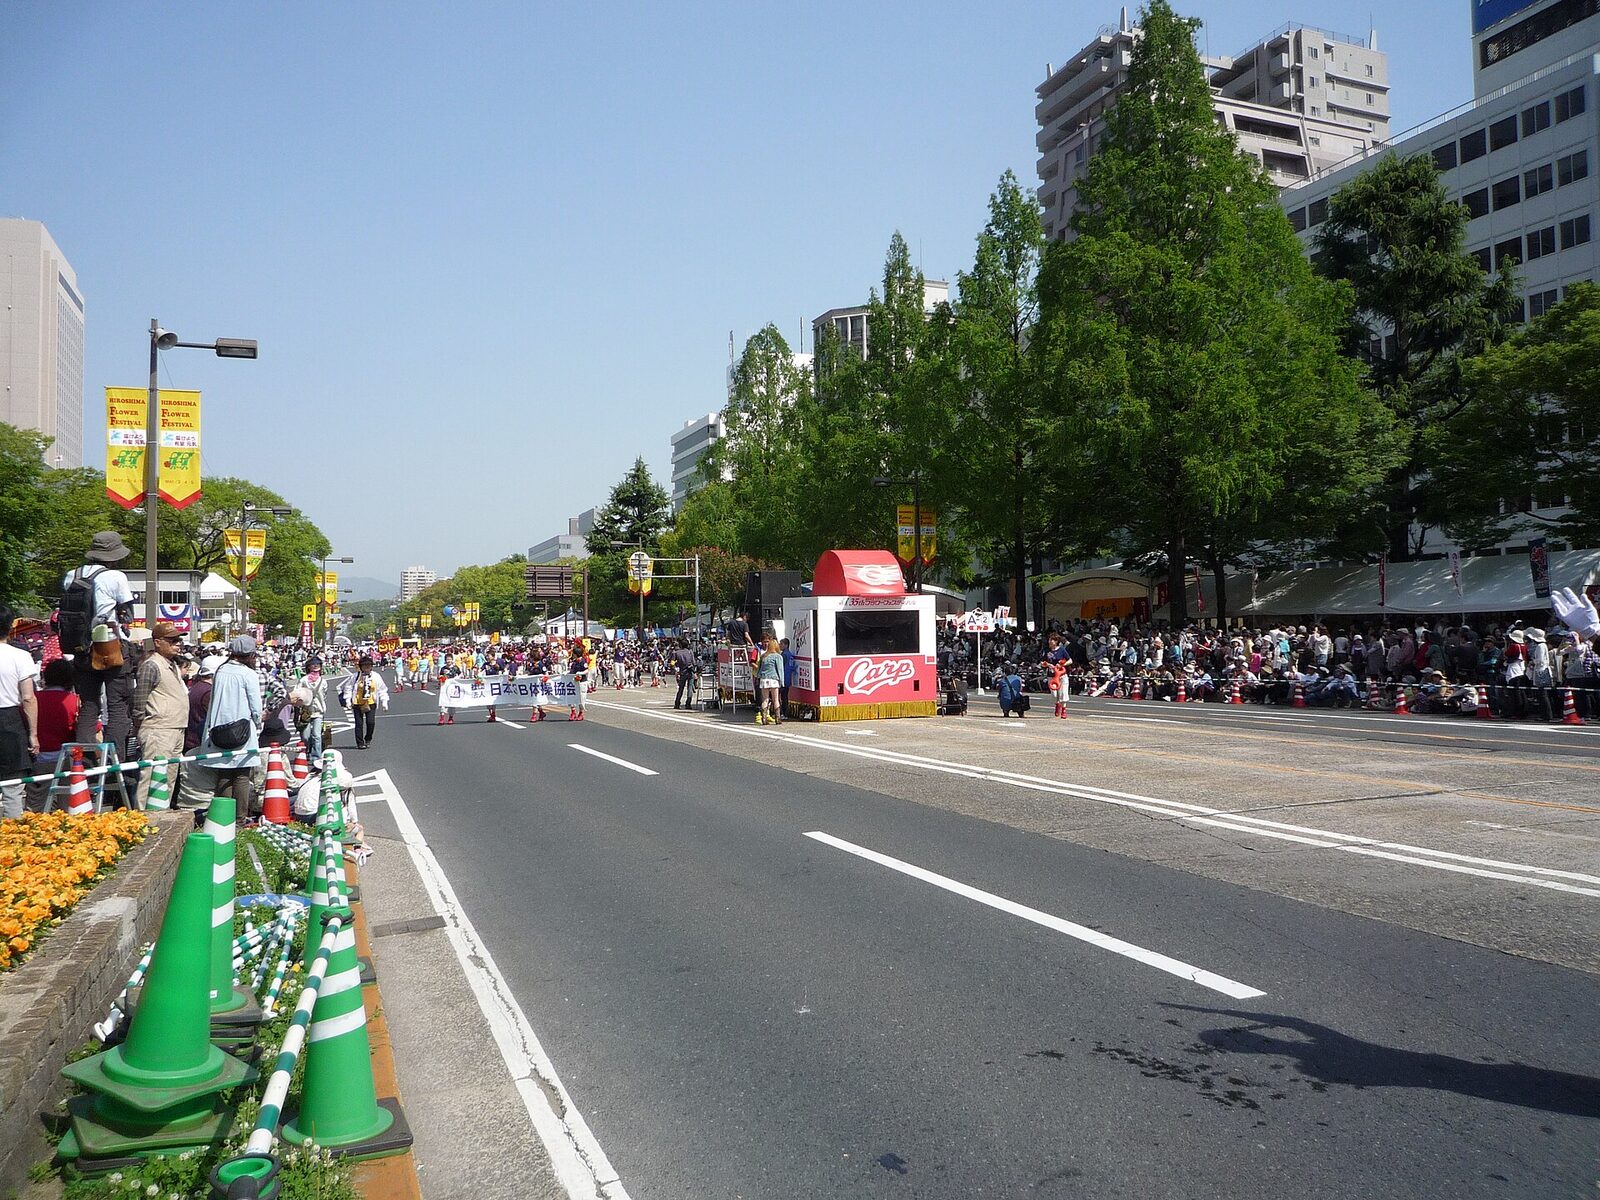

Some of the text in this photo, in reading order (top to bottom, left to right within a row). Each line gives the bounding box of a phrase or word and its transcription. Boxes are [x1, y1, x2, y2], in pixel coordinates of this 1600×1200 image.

[109, 397, 146, 405] HIROSHIMA
[161, 399, 197, 407] HIROSHIMA
[845, 658, 915, 695] Carp
